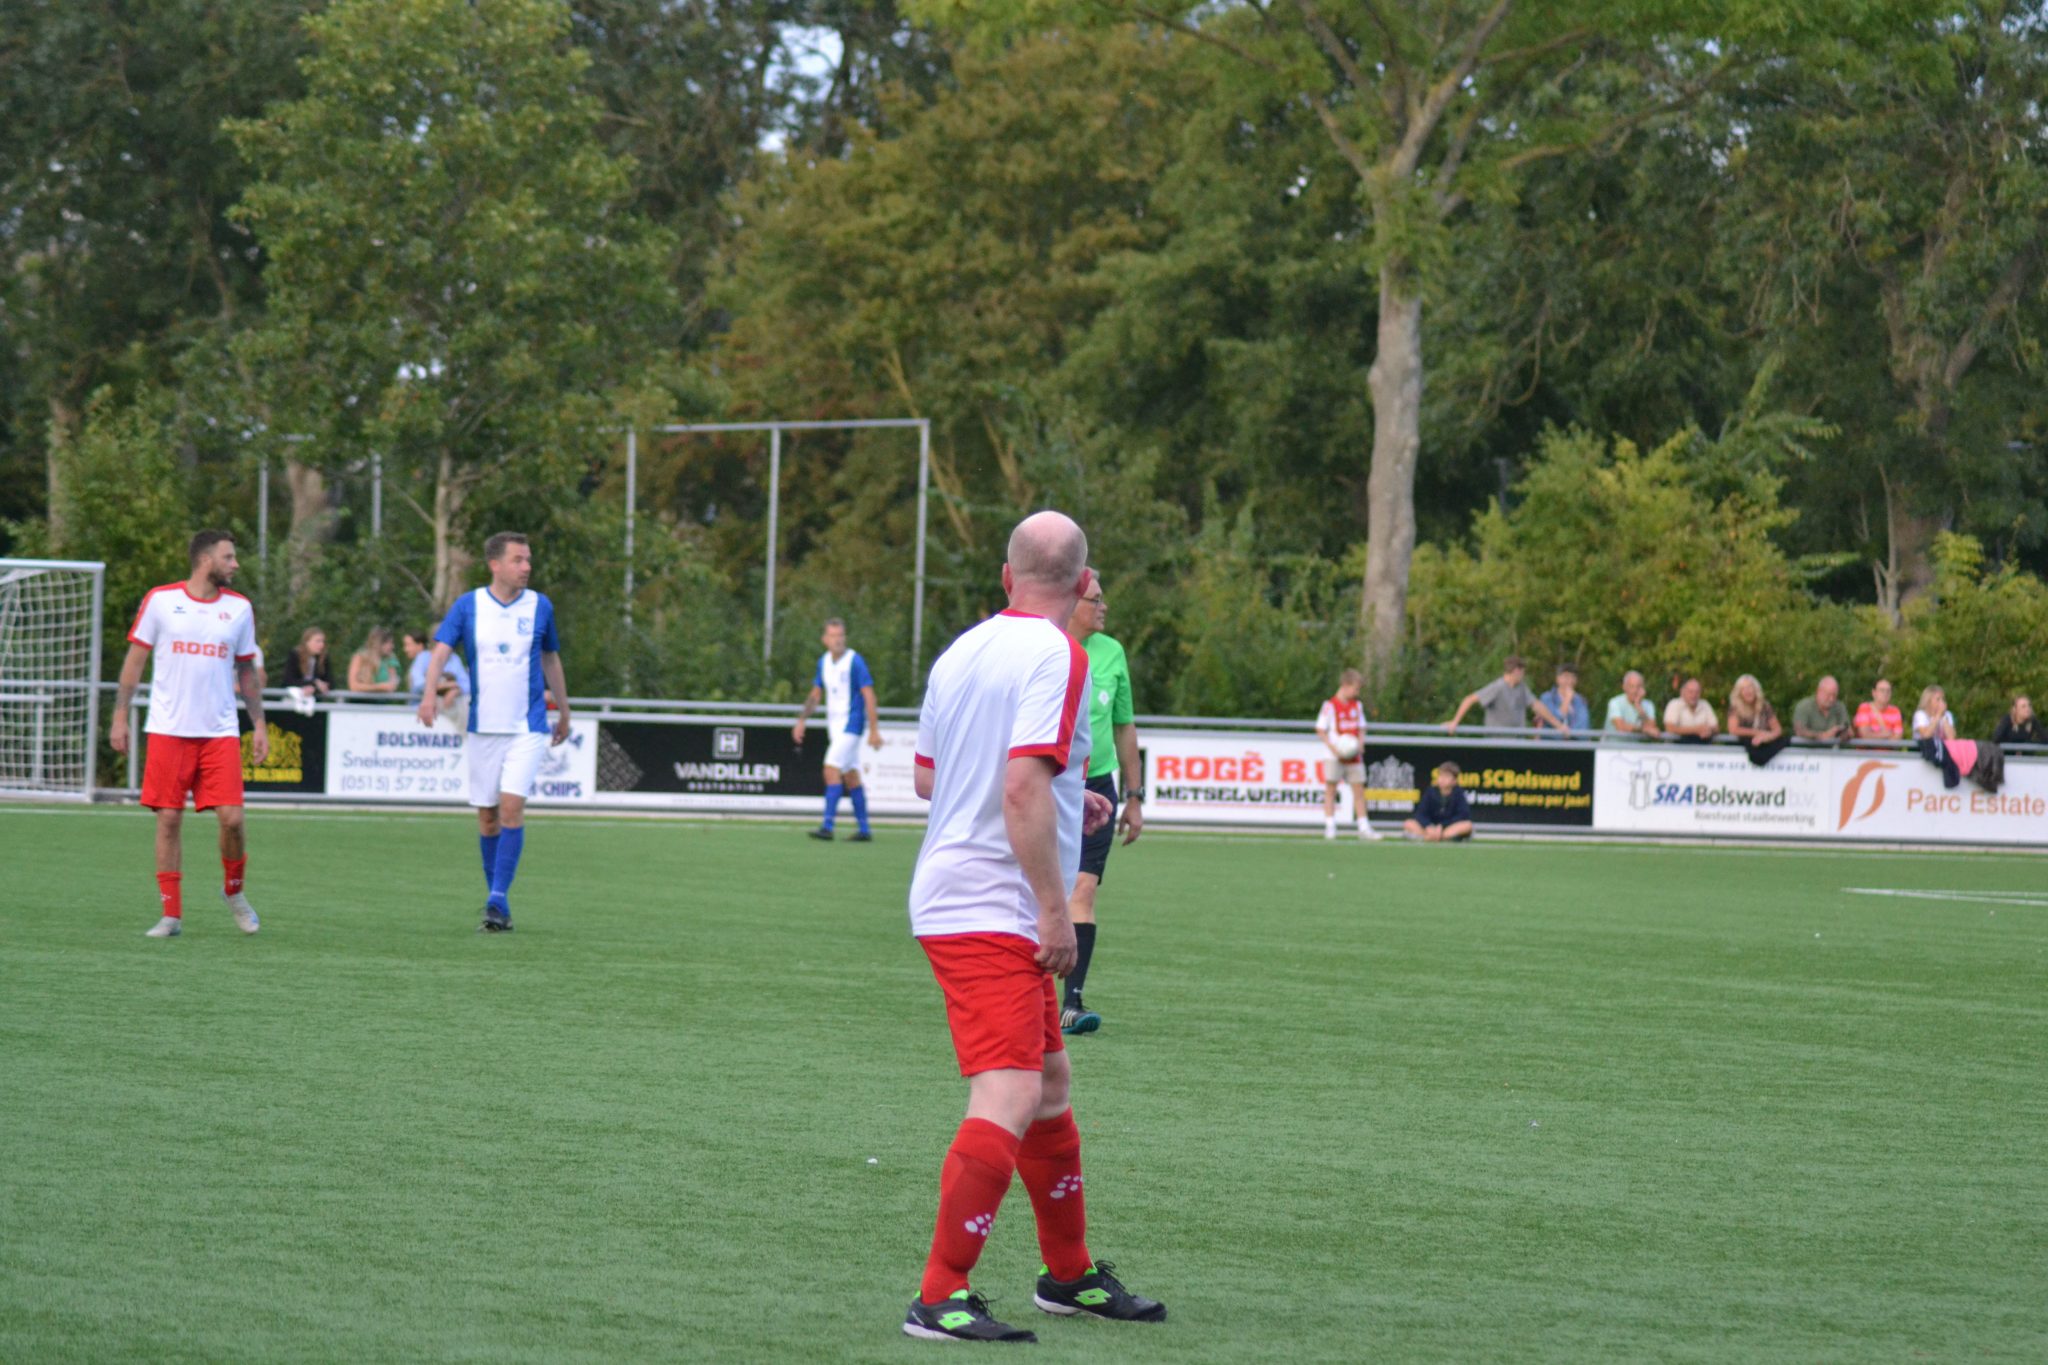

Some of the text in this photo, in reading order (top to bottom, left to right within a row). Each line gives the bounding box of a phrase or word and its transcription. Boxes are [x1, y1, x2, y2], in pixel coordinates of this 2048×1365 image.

[376, 731, 463, 748] BOLSWARD
[342, 750, 463, 773] Snekerpoort 7
[673, 762, 780, 782] VANDILLEN
[340, 775, 463, 793] (0515) 57 22 09
[1431, 767, 1581, 790] Sun SCBolsward
[1653, 783, 1693, 806] SRA
[1695, 785, 1786, 807] Bolsward
[1907, 789, 2046, 816] Parc Estate
